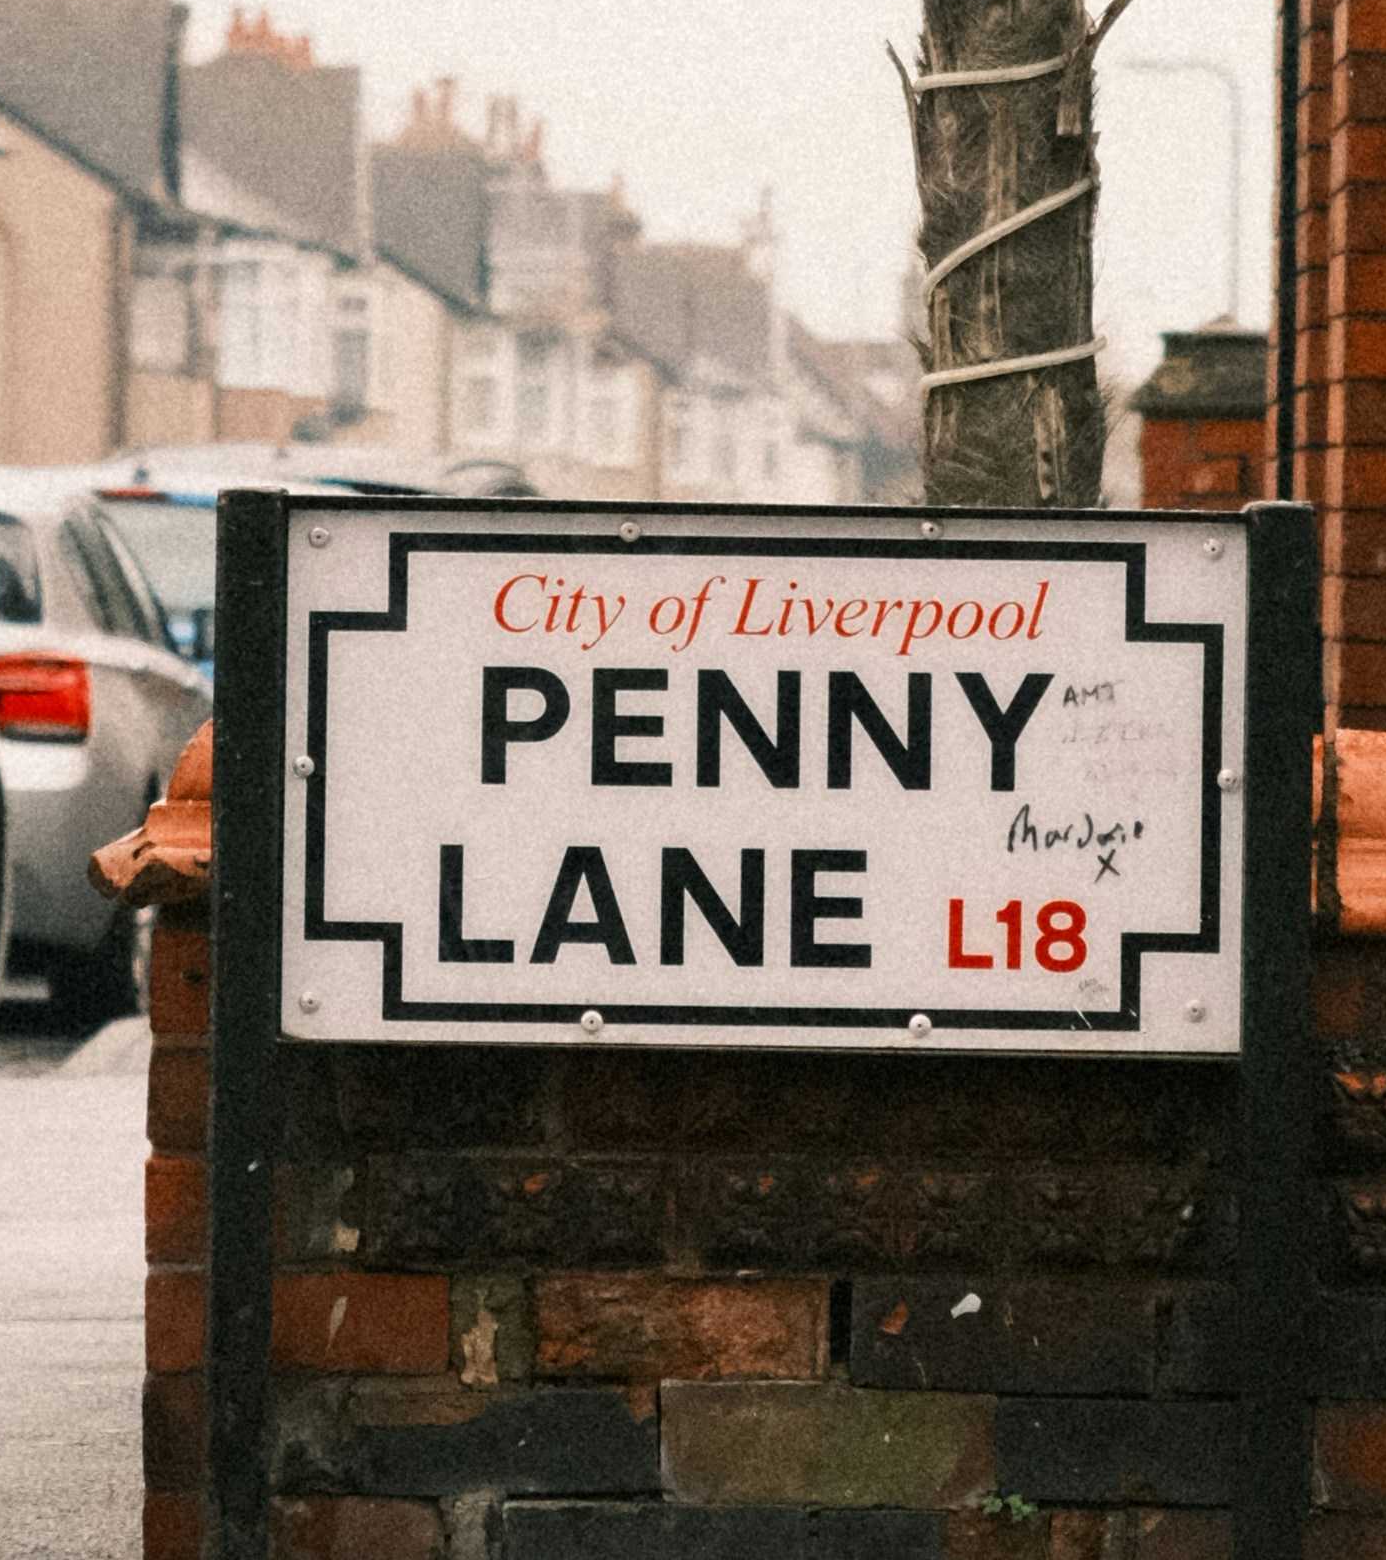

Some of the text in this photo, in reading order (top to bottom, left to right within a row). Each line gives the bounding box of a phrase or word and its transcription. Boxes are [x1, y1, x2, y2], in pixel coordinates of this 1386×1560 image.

[492, 574, 1050, 657] City of Liverpool
[481, 666, 1055, 792] PENNY
[438, 844, 872, 969] LANE
[946, 895, 1089, 975] L18
